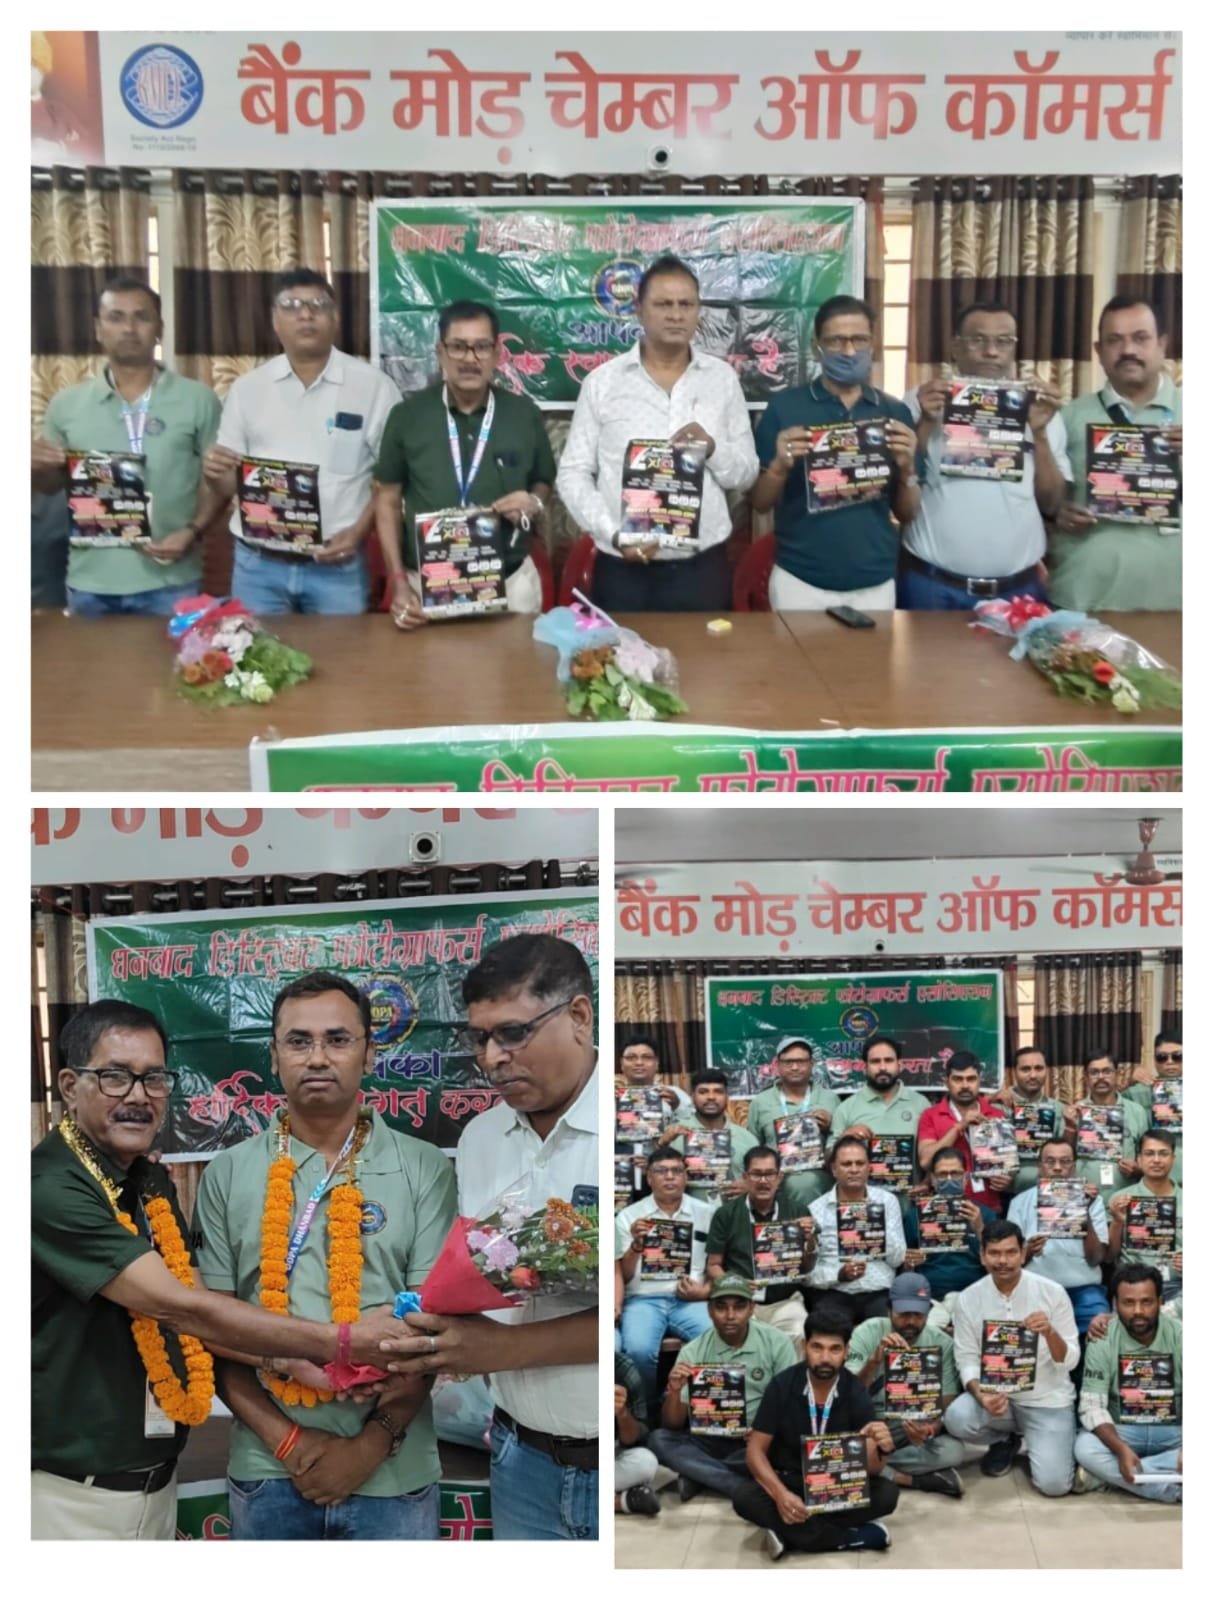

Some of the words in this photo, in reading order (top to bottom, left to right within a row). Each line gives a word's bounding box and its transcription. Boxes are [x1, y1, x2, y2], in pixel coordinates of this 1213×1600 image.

[238, 41, 371, 135] बैंक
[391, 48, 531, 164] मोड़
[543, 50, 740, 140] चेम्बर
[755, 49, 926, 141] ऑफ
[945, 48, 1176, 141] कॉमर्स
[615, 877, 701, 937] बैंक
[711, 880, 799, 952] मोड़
[807, 880, 927, 936] चेम्बर
[936, 875, 1041, 934] ऑफ
